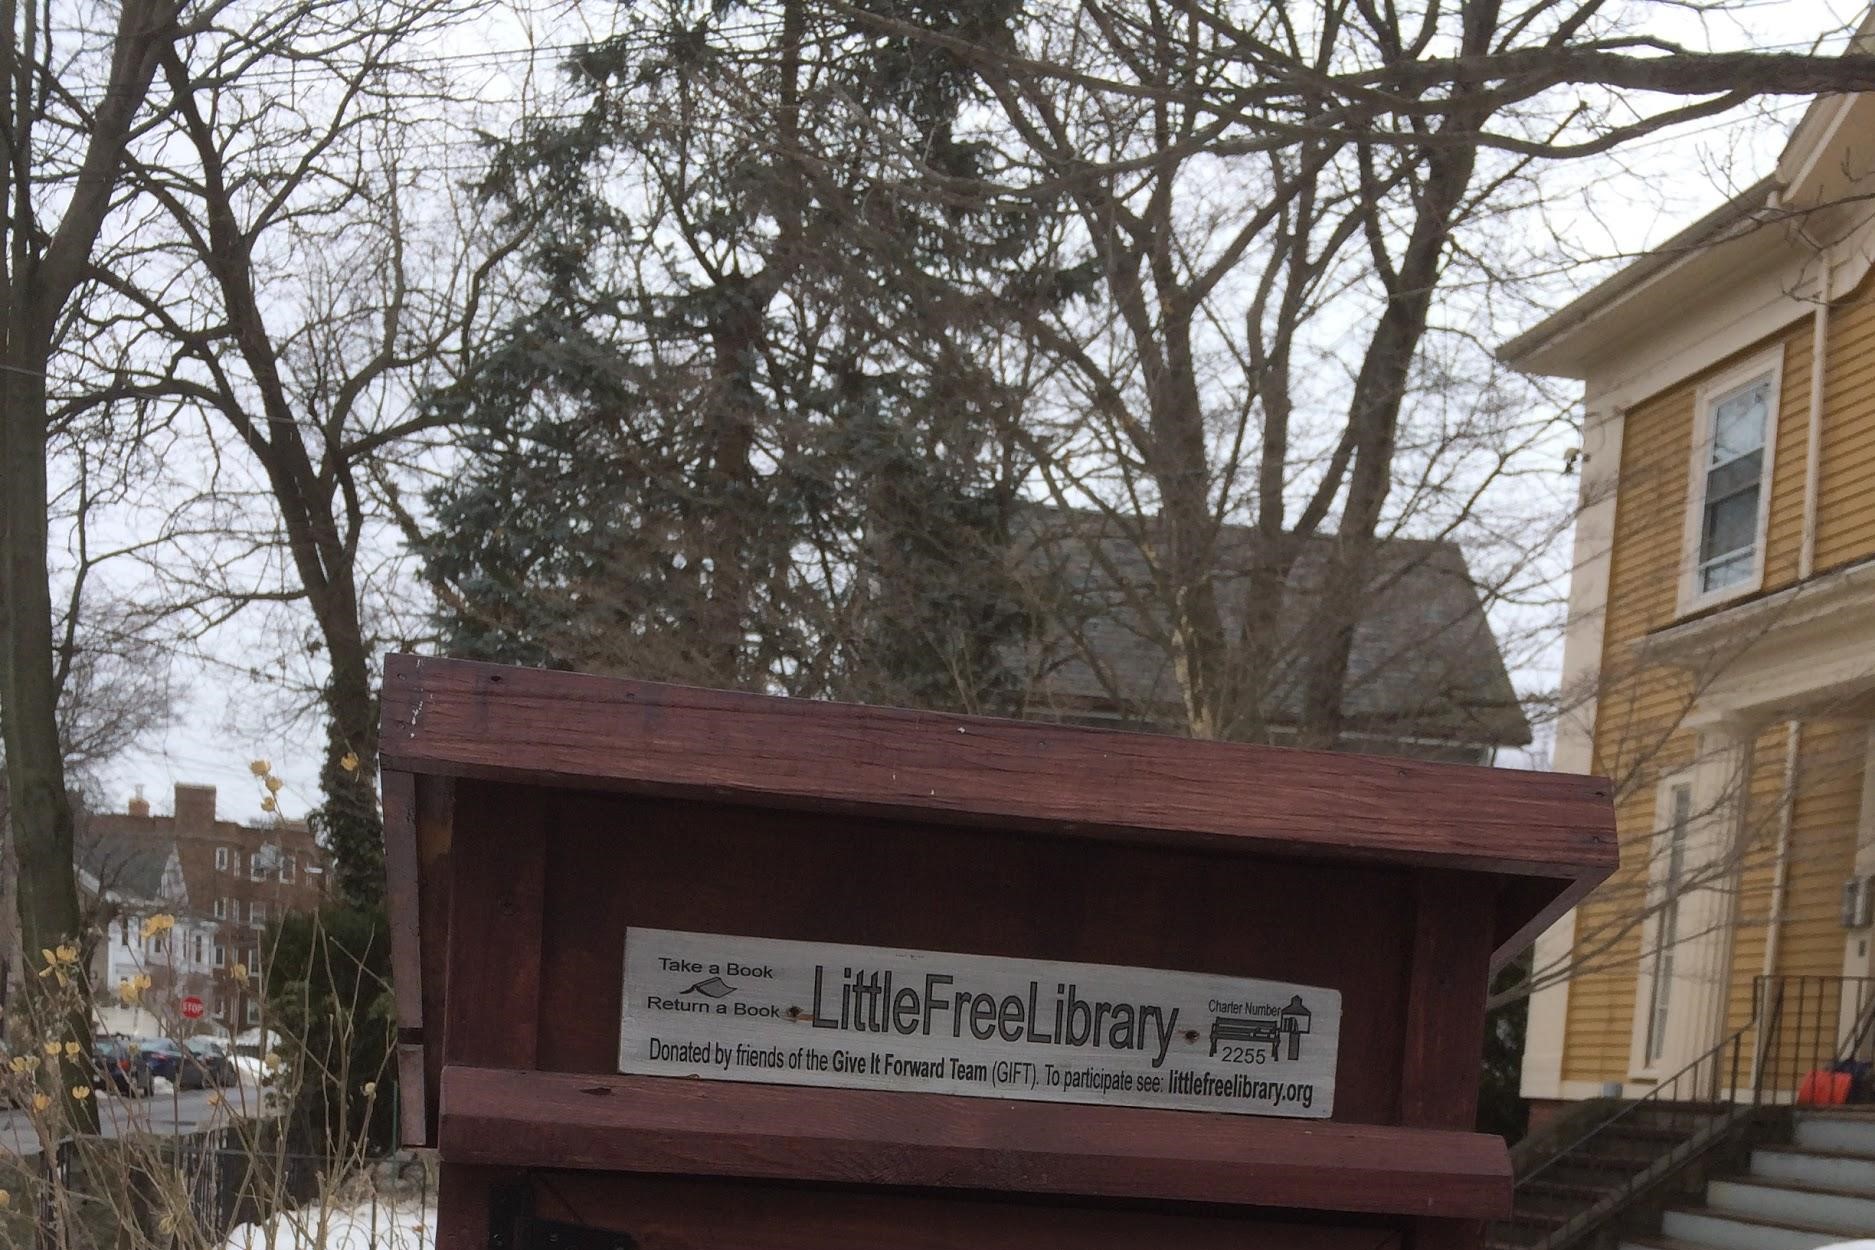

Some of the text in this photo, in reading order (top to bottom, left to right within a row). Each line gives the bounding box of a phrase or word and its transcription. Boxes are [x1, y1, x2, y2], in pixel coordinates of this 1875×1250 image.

[659, 958, 774, 979] Take a Book
[183, 1002, 204, 1014] STOP
[648, 996, 781, 1018] Return a Book
[813, 965, 1180, 1068] LittleFreeLibrary
[1208, 999, 1281, 1017] Charter Number
[1221, 1046, 1266, 1065] 2255
[650, 1037, 1313, 1109] Donated by friends of the Give It Forward Team (GIFT). To participate see: littlefreelibrary.org
